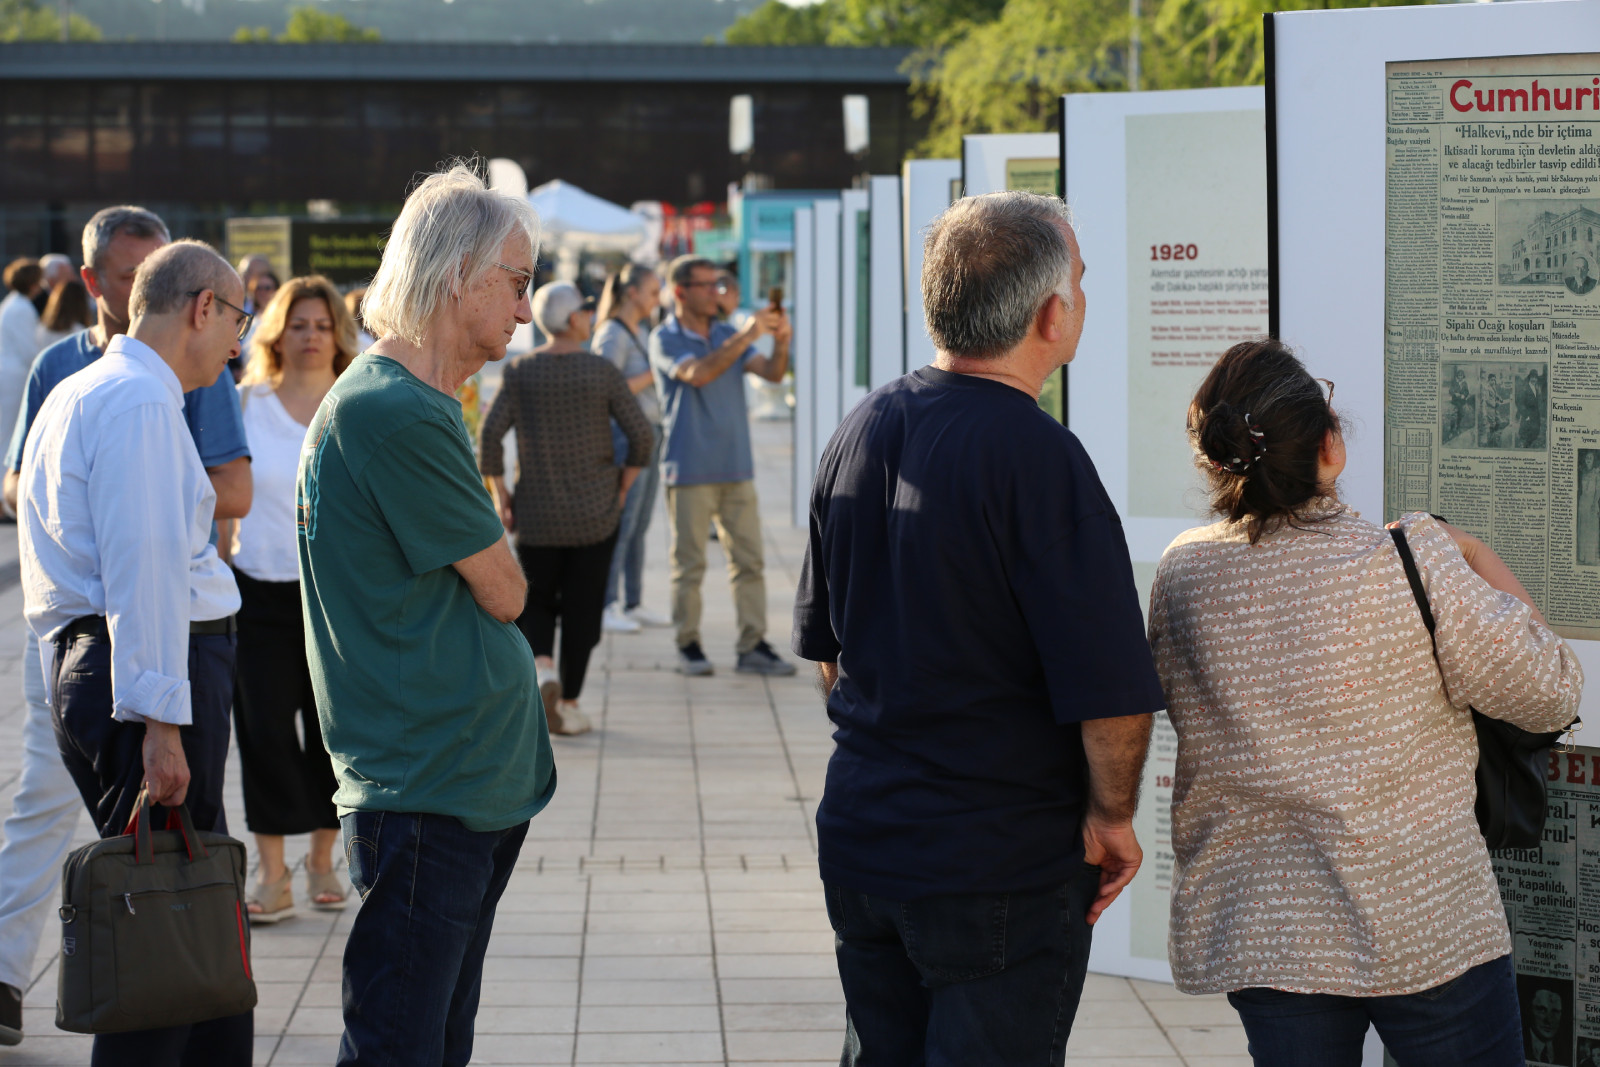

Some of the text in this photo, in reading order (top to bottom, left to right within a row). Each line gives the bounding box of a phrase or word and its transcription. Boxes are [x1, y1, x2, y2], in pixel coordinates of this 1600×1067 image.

[1450, 78, 1600, 112] Cumhuri
[1538, 124, 1554, 138] bir
[1557, 124, 1592, 140] içtima
[1481, 144, 1515, 156] koruma
[1519, 145, 1535, 157] için
[1538, 144, 1576, 155] devletin
[1462, 158, 1493, 172] alacağı
[1496, 158, 1536, 169] tedbirler
[1540, 159, 1567, 171] tasvip
[1536, 174, 1549, 183] yeni
[1559, 174, 1584, 183] Sakarya
[1150, 244, 1199, 261] 1920
[1446, 319, 1545, 332] Sipahi Ocağı koşuları
[1528, 938, 1564, 951] Yaşamak
